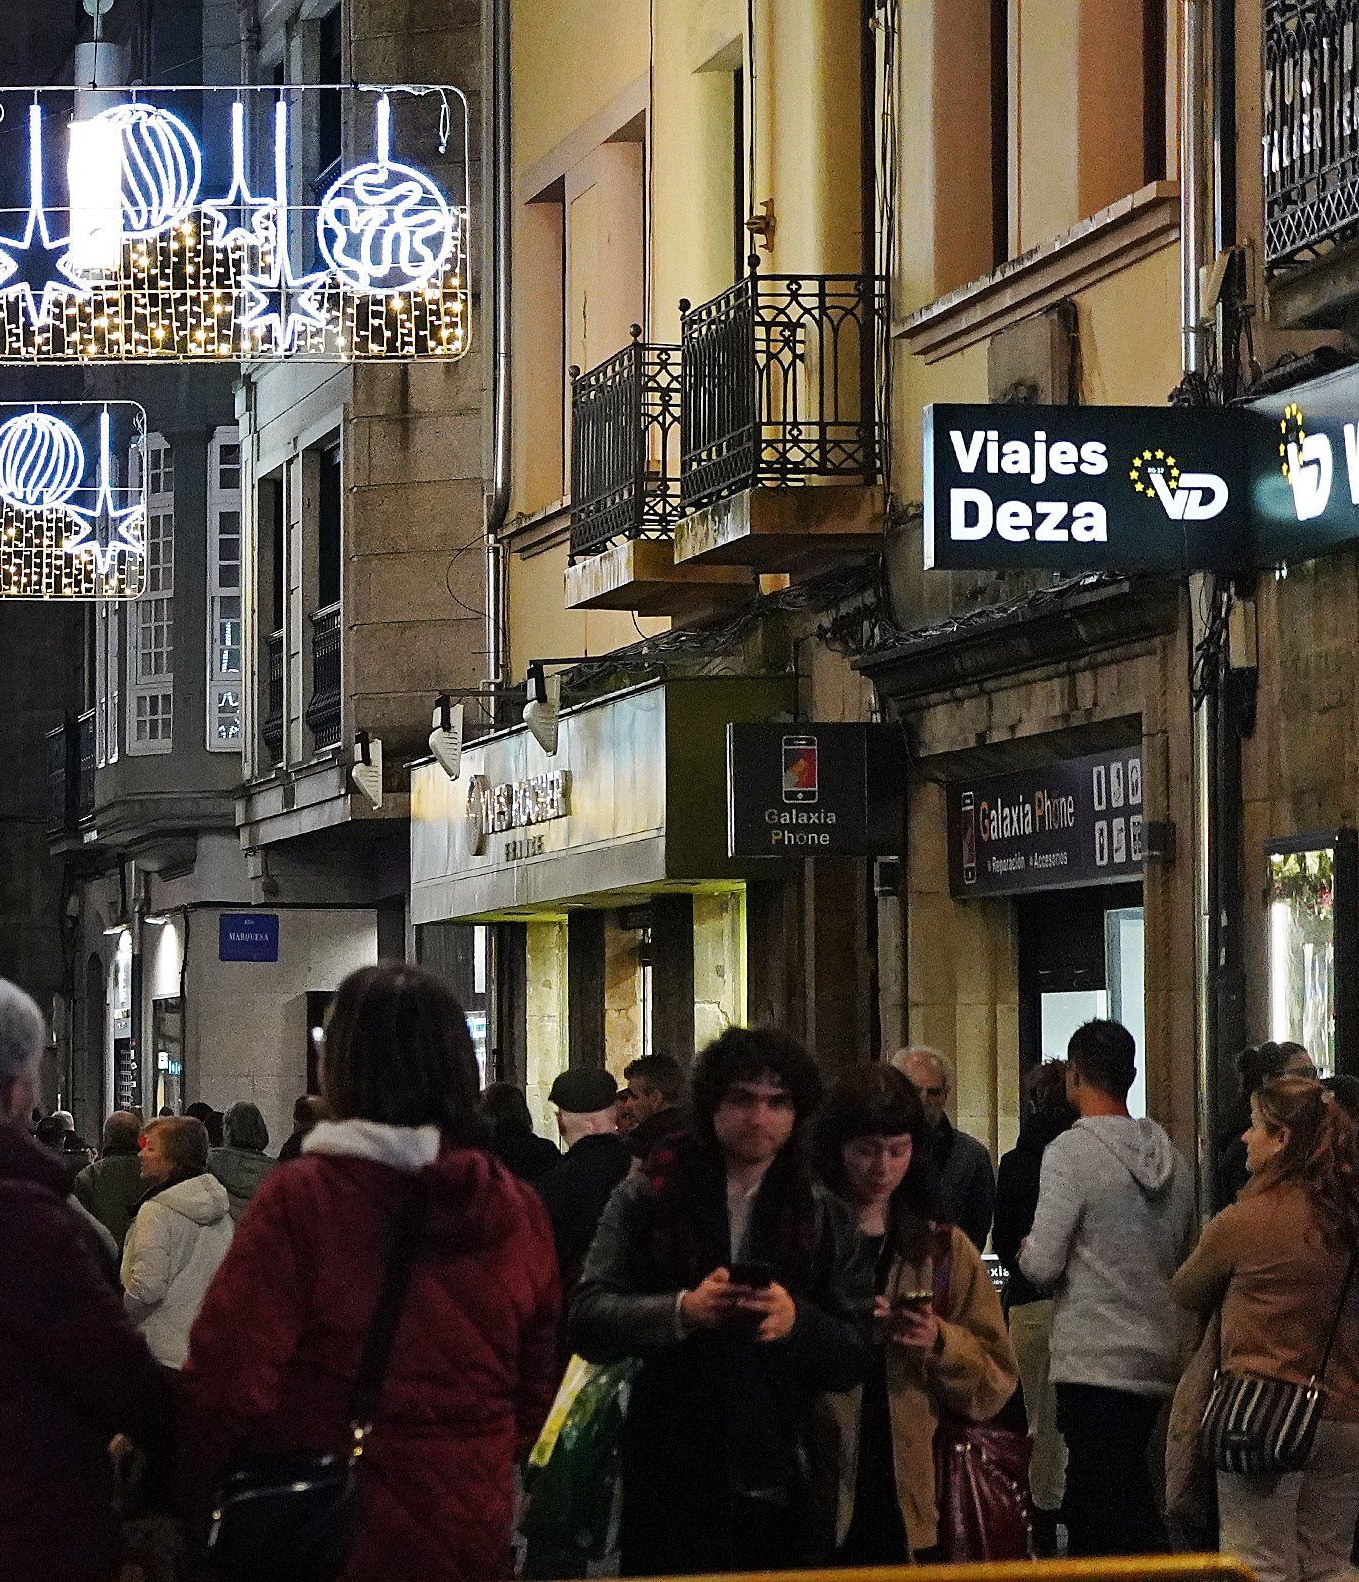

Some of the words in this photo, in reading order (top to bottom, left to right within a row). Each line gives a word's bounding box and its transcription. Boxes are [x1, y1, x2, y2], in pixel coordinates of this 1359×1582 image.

[949, 430, 1108, 484] Viajes
[950, 487, 1108, 542] Deza
[765, 808, 836, 824] Galaxia
[979, 794, 1033, 842] Galaxia
[1035, 789, 1075, 832] Phone
[771, 829, 830, 845] Phone
[229, 932, 269, 942] MARQUESA
